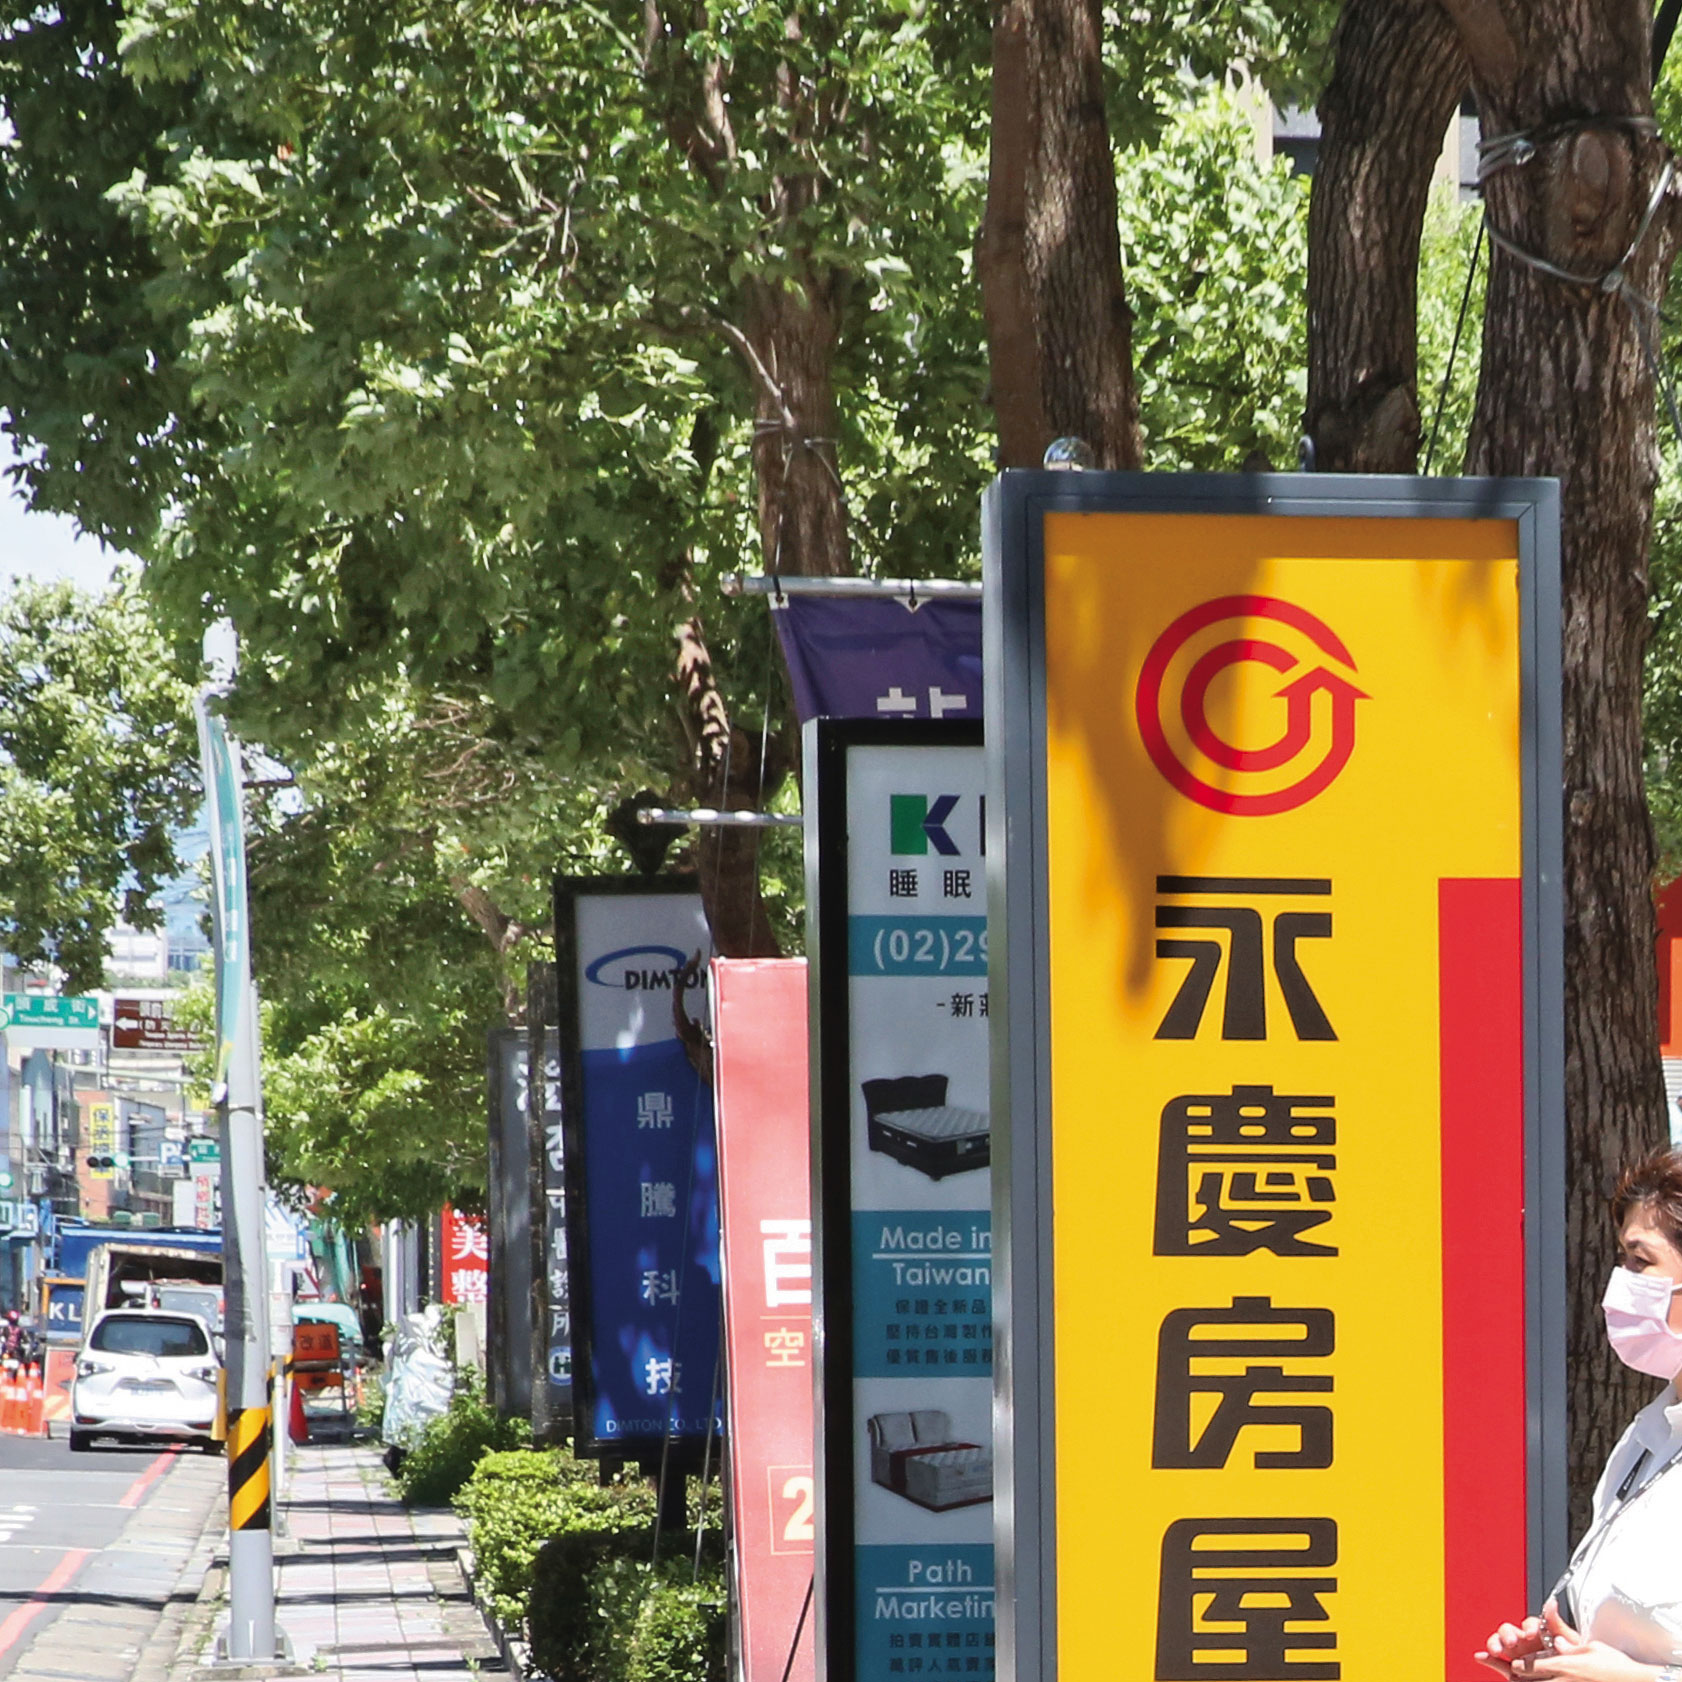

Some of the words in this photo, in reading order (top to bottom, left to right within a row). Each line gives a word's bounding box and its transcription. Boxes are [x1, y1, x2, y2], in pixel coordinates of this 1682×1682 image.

[889, 868, 972, 899] 睡眠
[636, 1091, 682, 1395] 鼎騰科技
[880, 1226, 962, 1249] Made
[971, 1226, 992, 1249] in
[892, 1262, 990, 1286] Taiwan
[1151, 875, 1342, 1682] 永慶房屋
[764, 1327, 806, 1368] 空
[908, 1559, 972, 1583] Path
